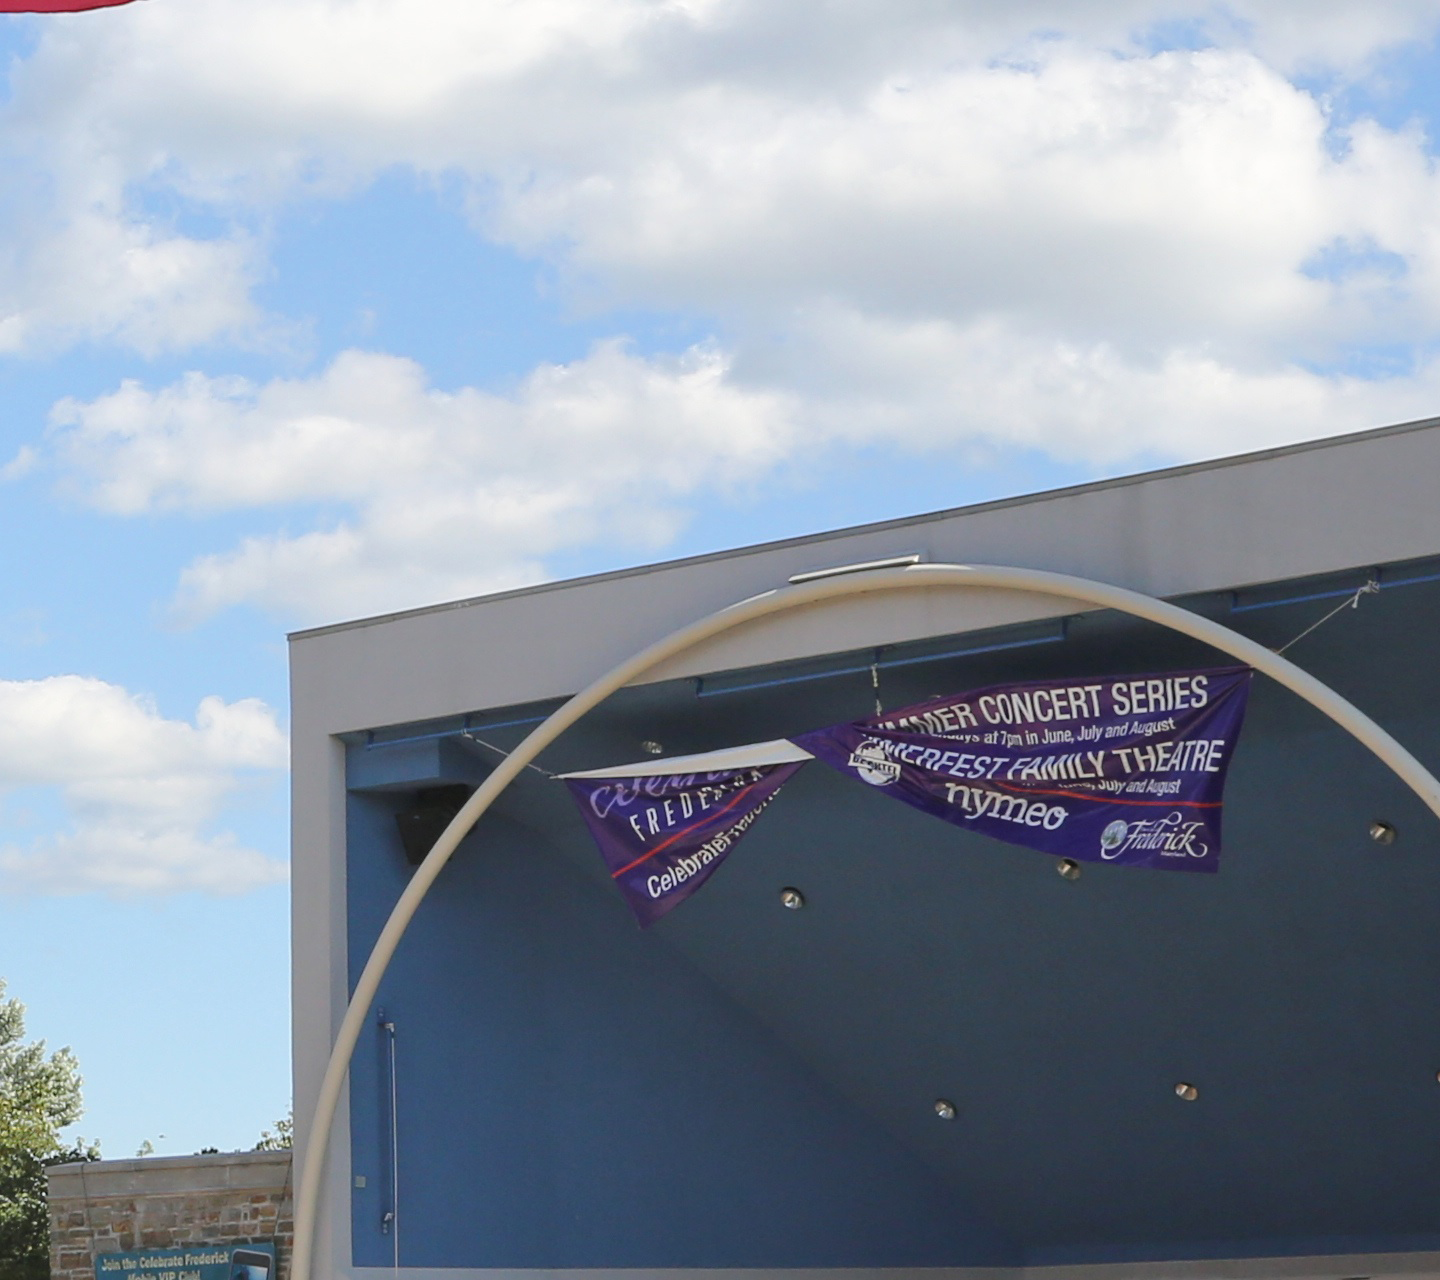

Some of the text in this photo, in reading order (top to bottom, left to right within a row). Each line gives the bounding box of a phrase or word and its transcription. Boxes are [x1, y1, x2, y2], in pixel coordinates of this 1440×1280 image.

[978, 684, 1102, 725] CONCERT
[1111, 675, 1209, 716] SERIES
[983, 732, 997, 745] at
[1025, 730, 1039, 745] in
[1042, 729, 1074, 746] June,
[1077, 725, 1103, 743] July
[1105, 721, 1128, 739] and
[1129, 717, 1176, 737] August
[1007, 749, 1105, 781] FAMILY
[1112, 740, 1225, 773] THEATRE
[1098, 779, 1124, 795] July
[1125, 779, 1147, 793] and
[1147, 778, 1182, 797] August
[945, 782, 1069, 830] nymeo
[101, 1252, 229, 1271] Join the Celebrate Frederick
